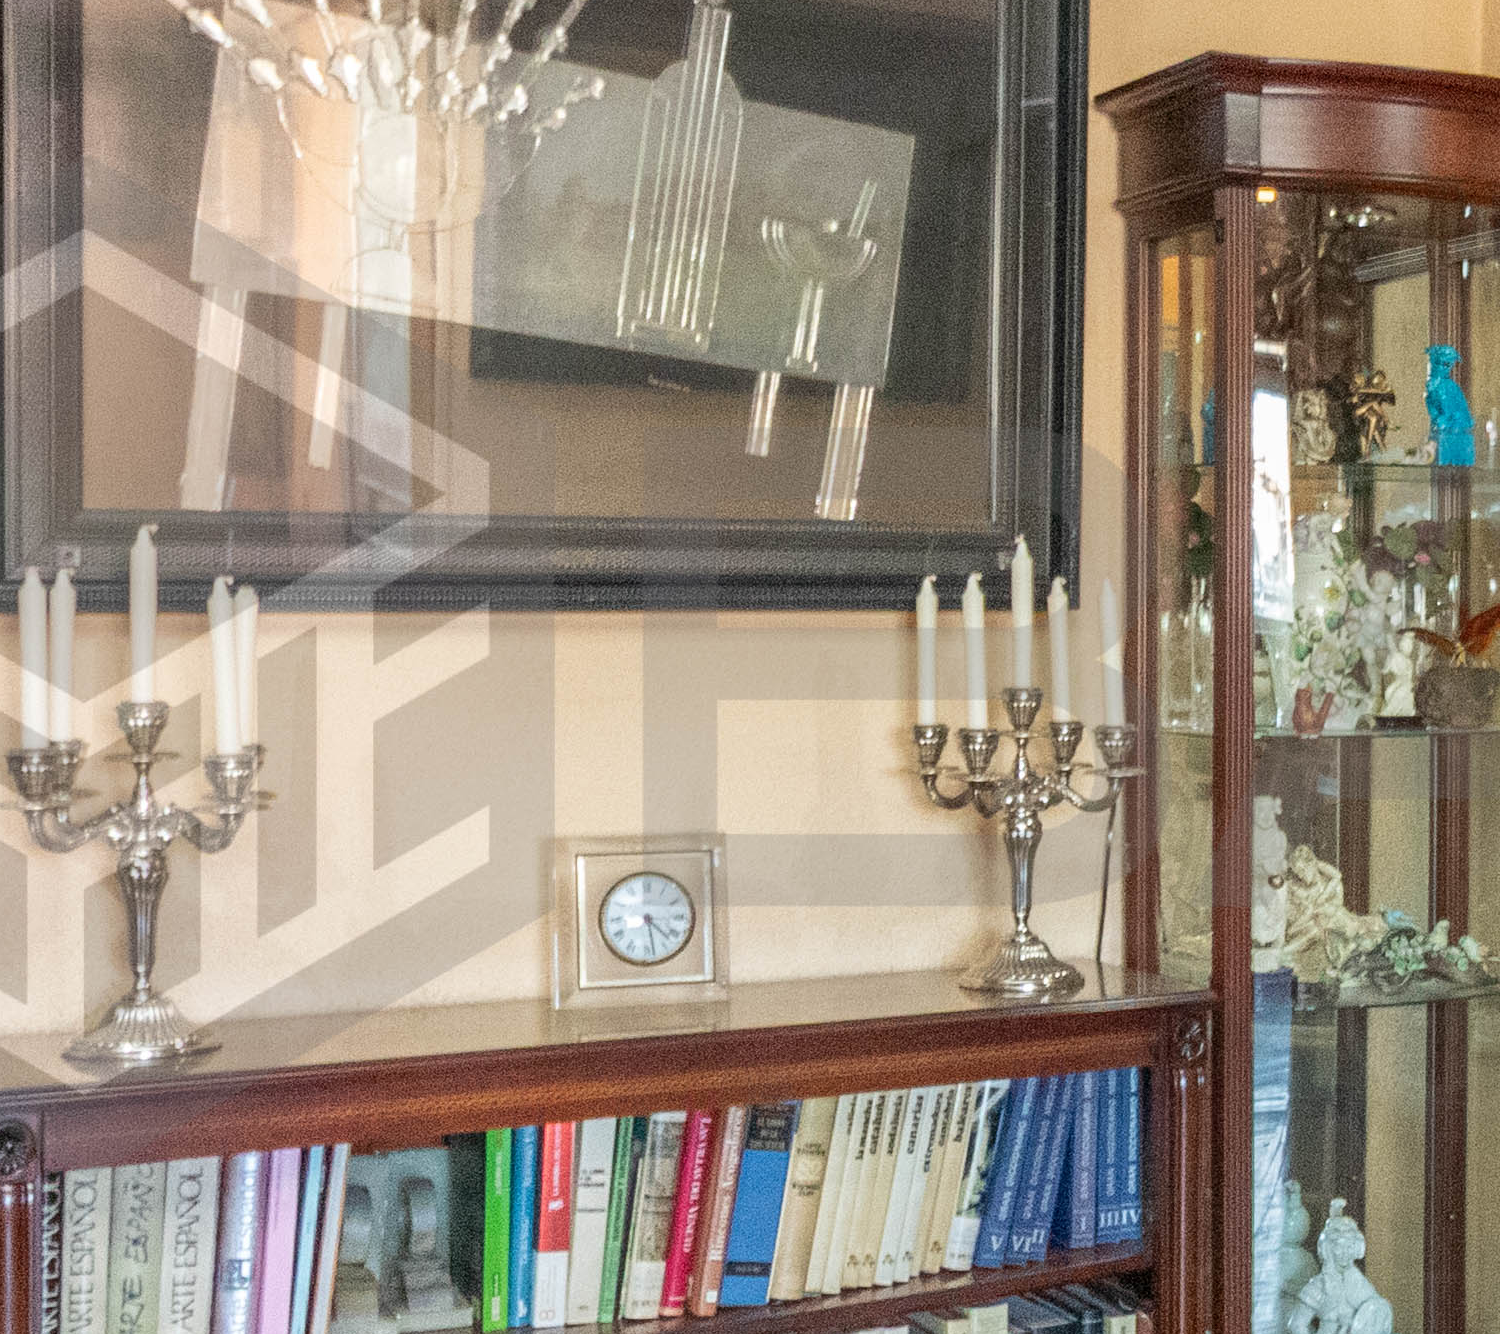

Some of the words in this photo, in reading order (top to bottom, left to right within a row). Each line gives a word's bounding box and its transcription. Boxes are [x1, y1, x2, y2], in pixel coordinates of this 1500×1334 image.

[906, 1095, 924, 1154] canarias
[70, 1173, 98, 1276] ESPAÑOL
[124, 1163, 153, 1264] ESPAÑO
[174, 1166, 203, 1268] ESPAÑOL
[1121, 1209, 1140, 1224] IV
[991, 1235, 1005, 1251] V
[1012, 1236, 1032, 1253] VI
[171, 1274, 196, 1331] ARTE
